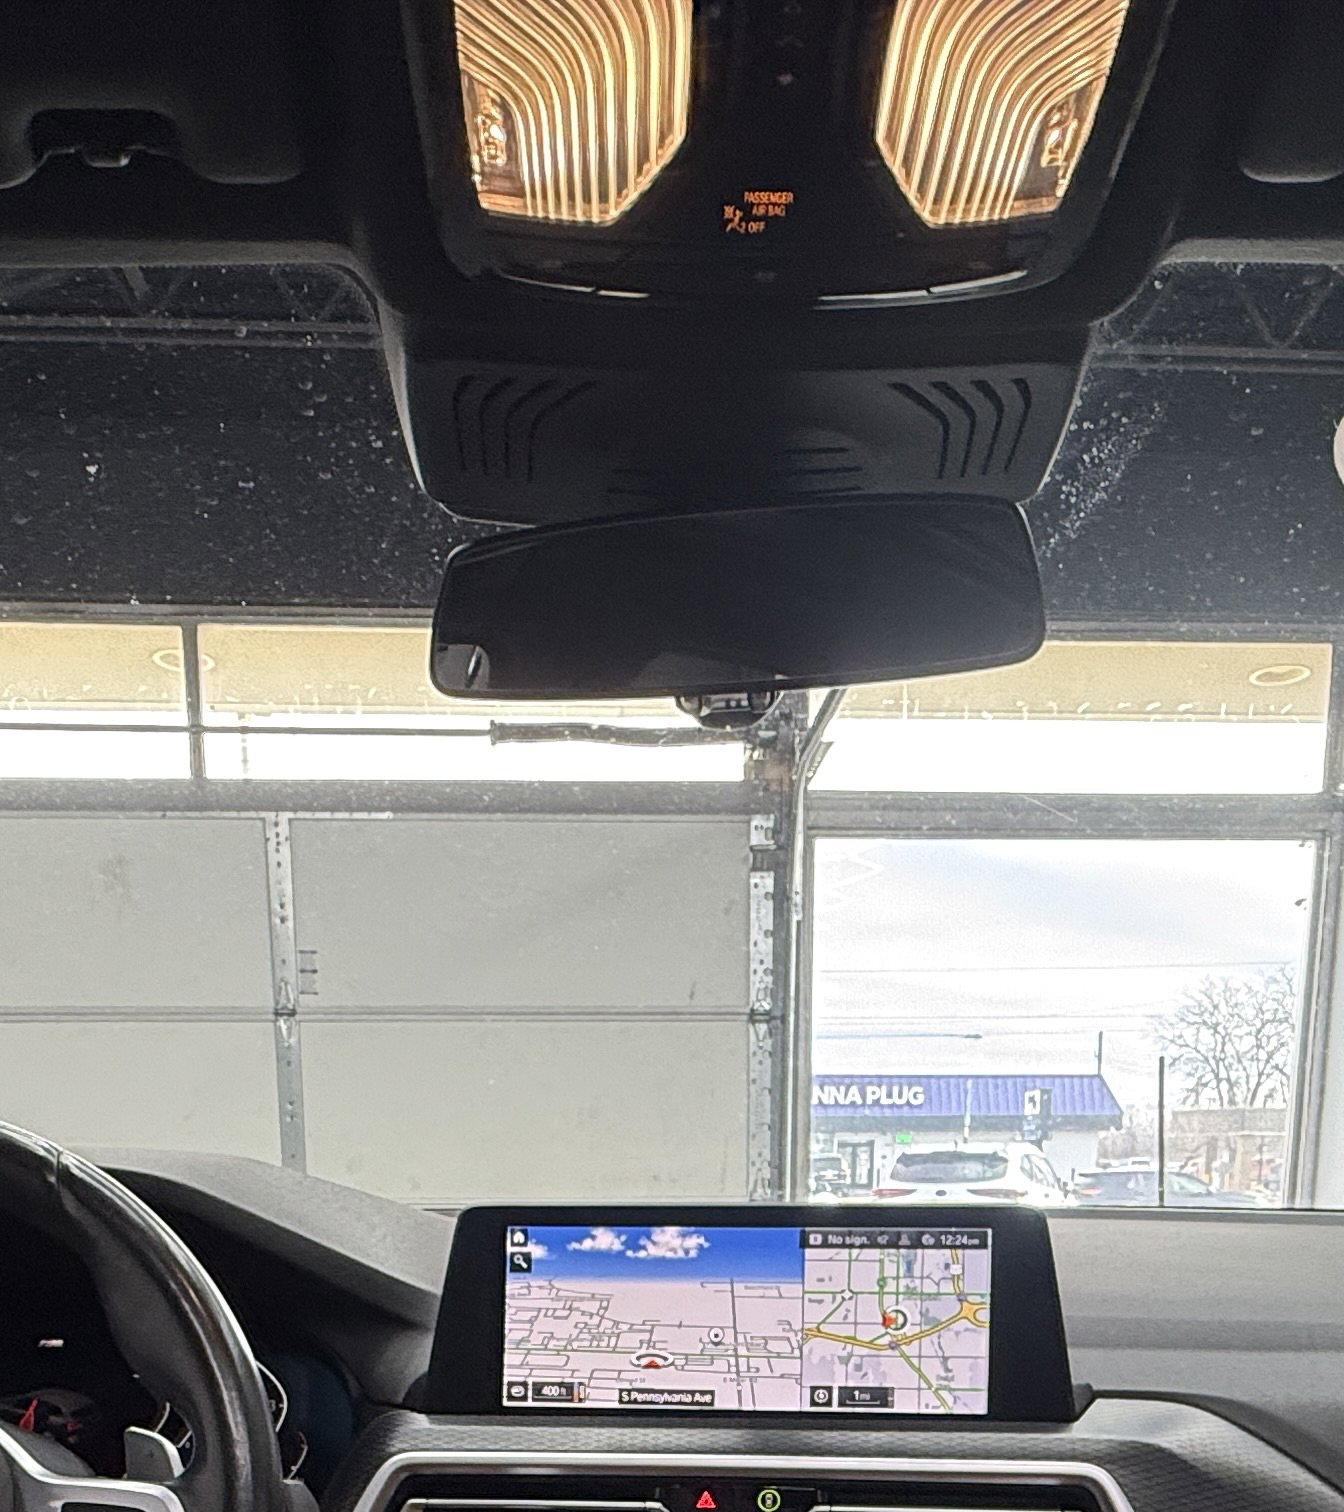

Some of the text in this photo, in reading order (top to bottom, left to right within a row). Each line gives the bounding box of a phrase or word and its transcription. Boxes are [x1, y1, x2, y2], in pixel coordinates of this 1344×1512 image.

[744, 191, 794, 203] PASSENGER
[752, 205, 786, 216] AIR BAG
[748, 221, 765, 233] OFF
[865, 1085, 924, 1105] PLUG
[828, 1234, 870, 1247] No sign.
[541, 1385, 559, 1396] 400
[621, 1391, 713, 1404] S Pennsylvania Ave
